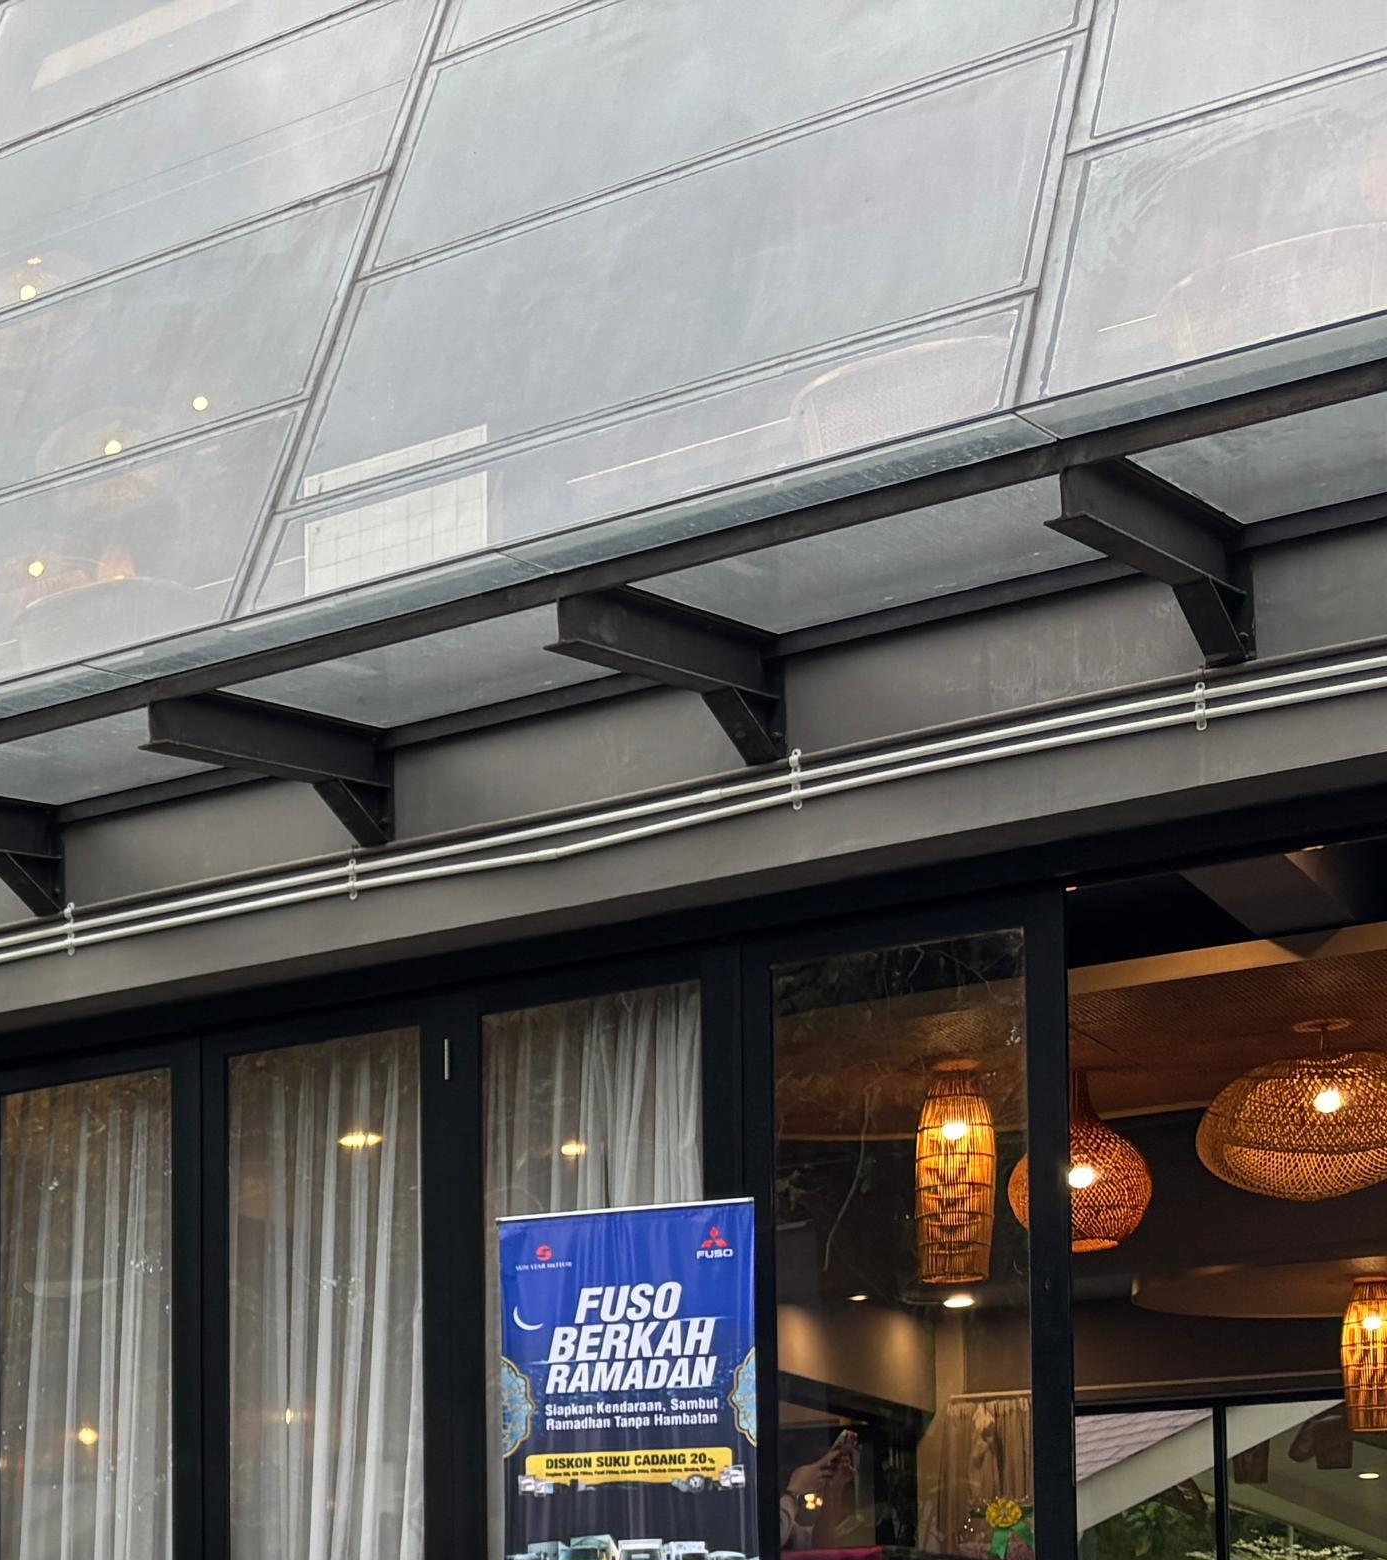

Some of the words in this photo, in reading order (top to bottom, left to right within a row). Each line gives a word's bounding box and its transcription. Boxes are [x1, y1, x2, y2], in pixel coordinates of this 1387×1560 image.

[696, 1248, 733, 1259] FUSO
[574, 1281, 682, 1324] FUSO
[548, 1317, 716, 1362] BERKAH
[545, 1356, 717, 1394] RAMADAN
[545, 1403, 593, 1418] Siapkan
[597, 1400, 666, 1414] Kendaraan,
[670, 1397, 718, 1411] Sambut
[546, 1417, 611, 1431] Ramadhan
[614, 1415, 650, 1429] Tanpa
[654, 1412, 718, 1426] Hambatan
[545, 1457, 592, 1469] DISKON
[596, 1456, 629, 1468] SUKU
[634, 1453, 686, 1466] CADANG
